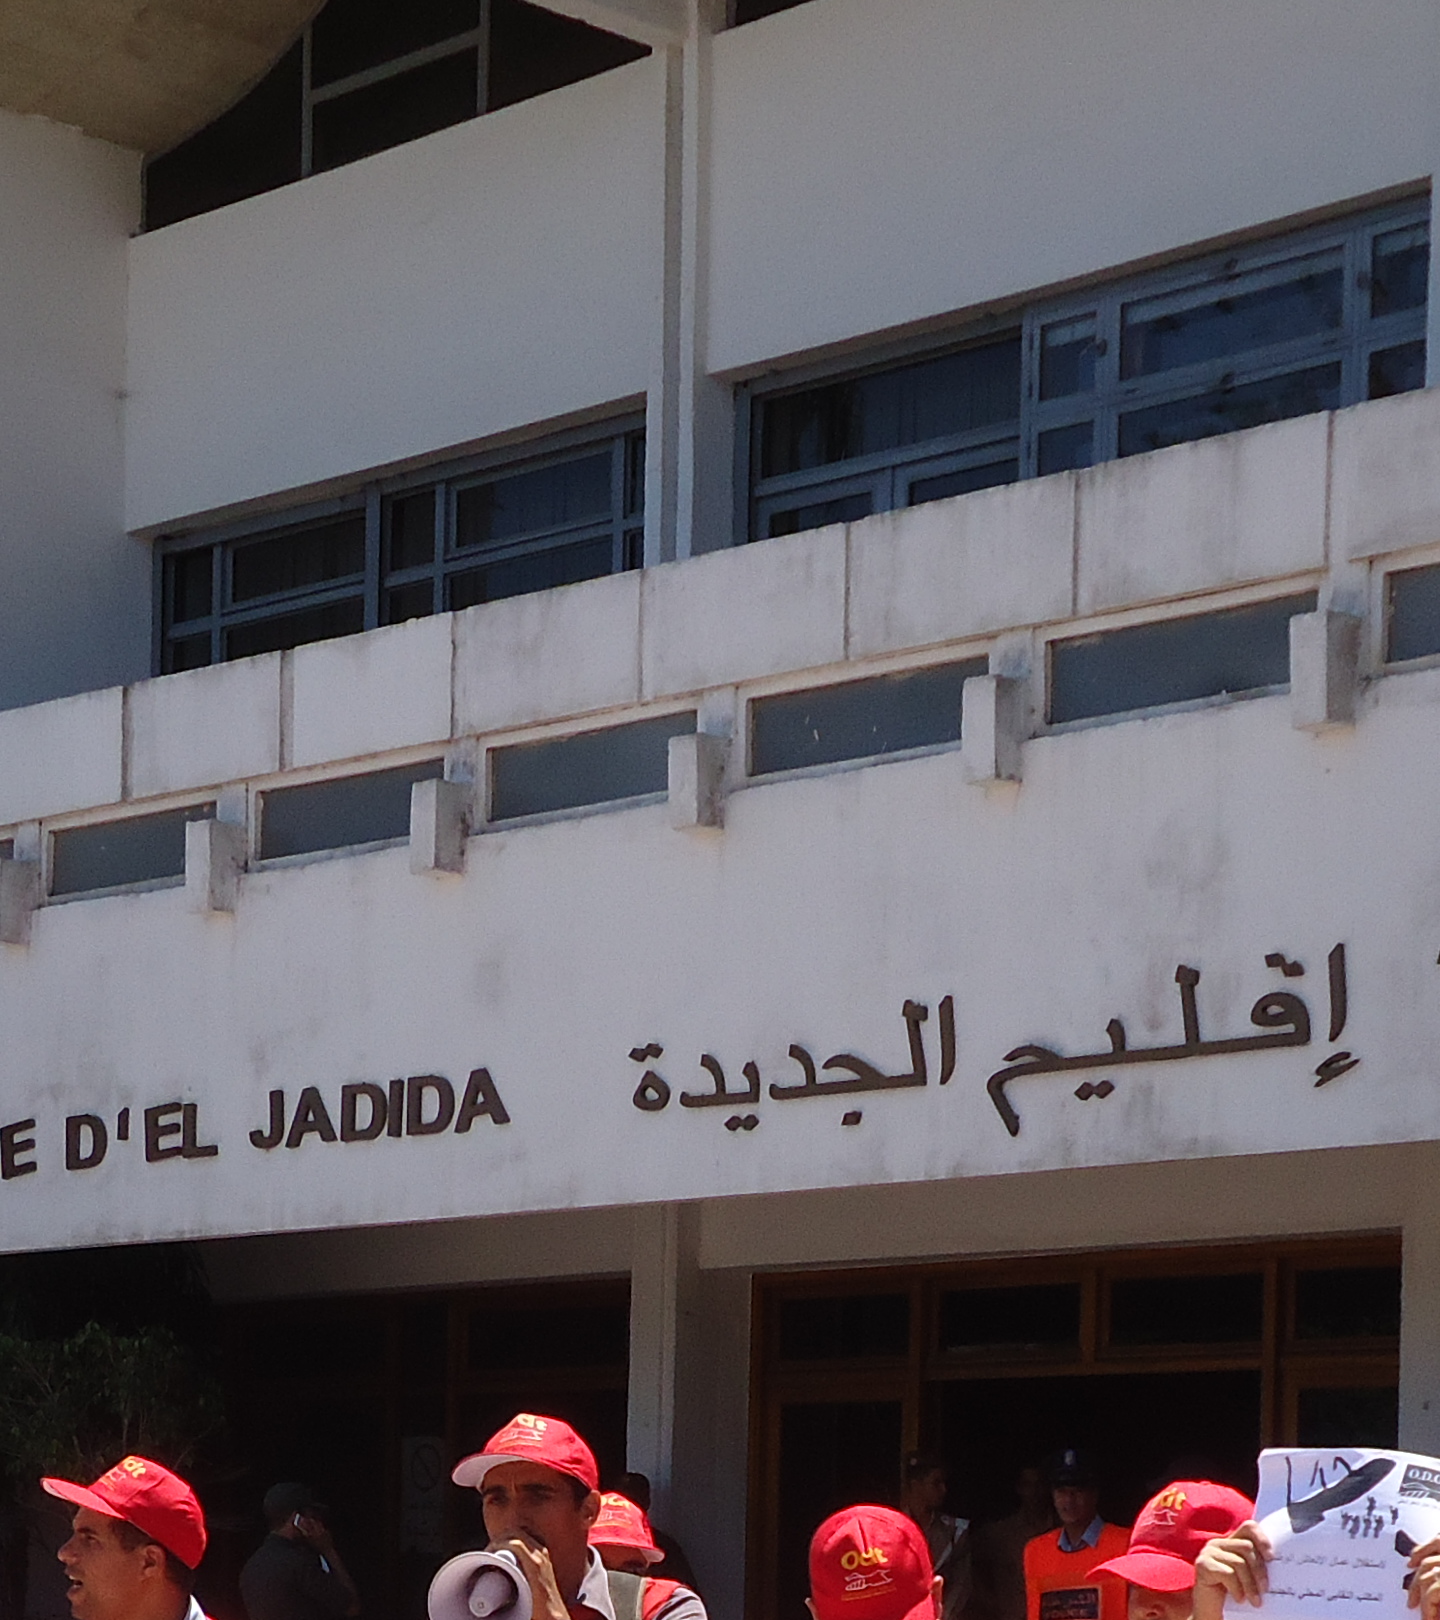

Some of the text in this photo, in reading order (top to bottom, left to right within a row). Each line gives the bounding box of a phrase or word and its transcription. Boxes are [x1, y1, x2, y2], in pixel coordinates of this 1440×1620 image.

[247, 1066, 512, 1153] JADIDA
[627, 993, 958, 1133] الجديدة
[985, 941, 1362, 1139] إقليم
